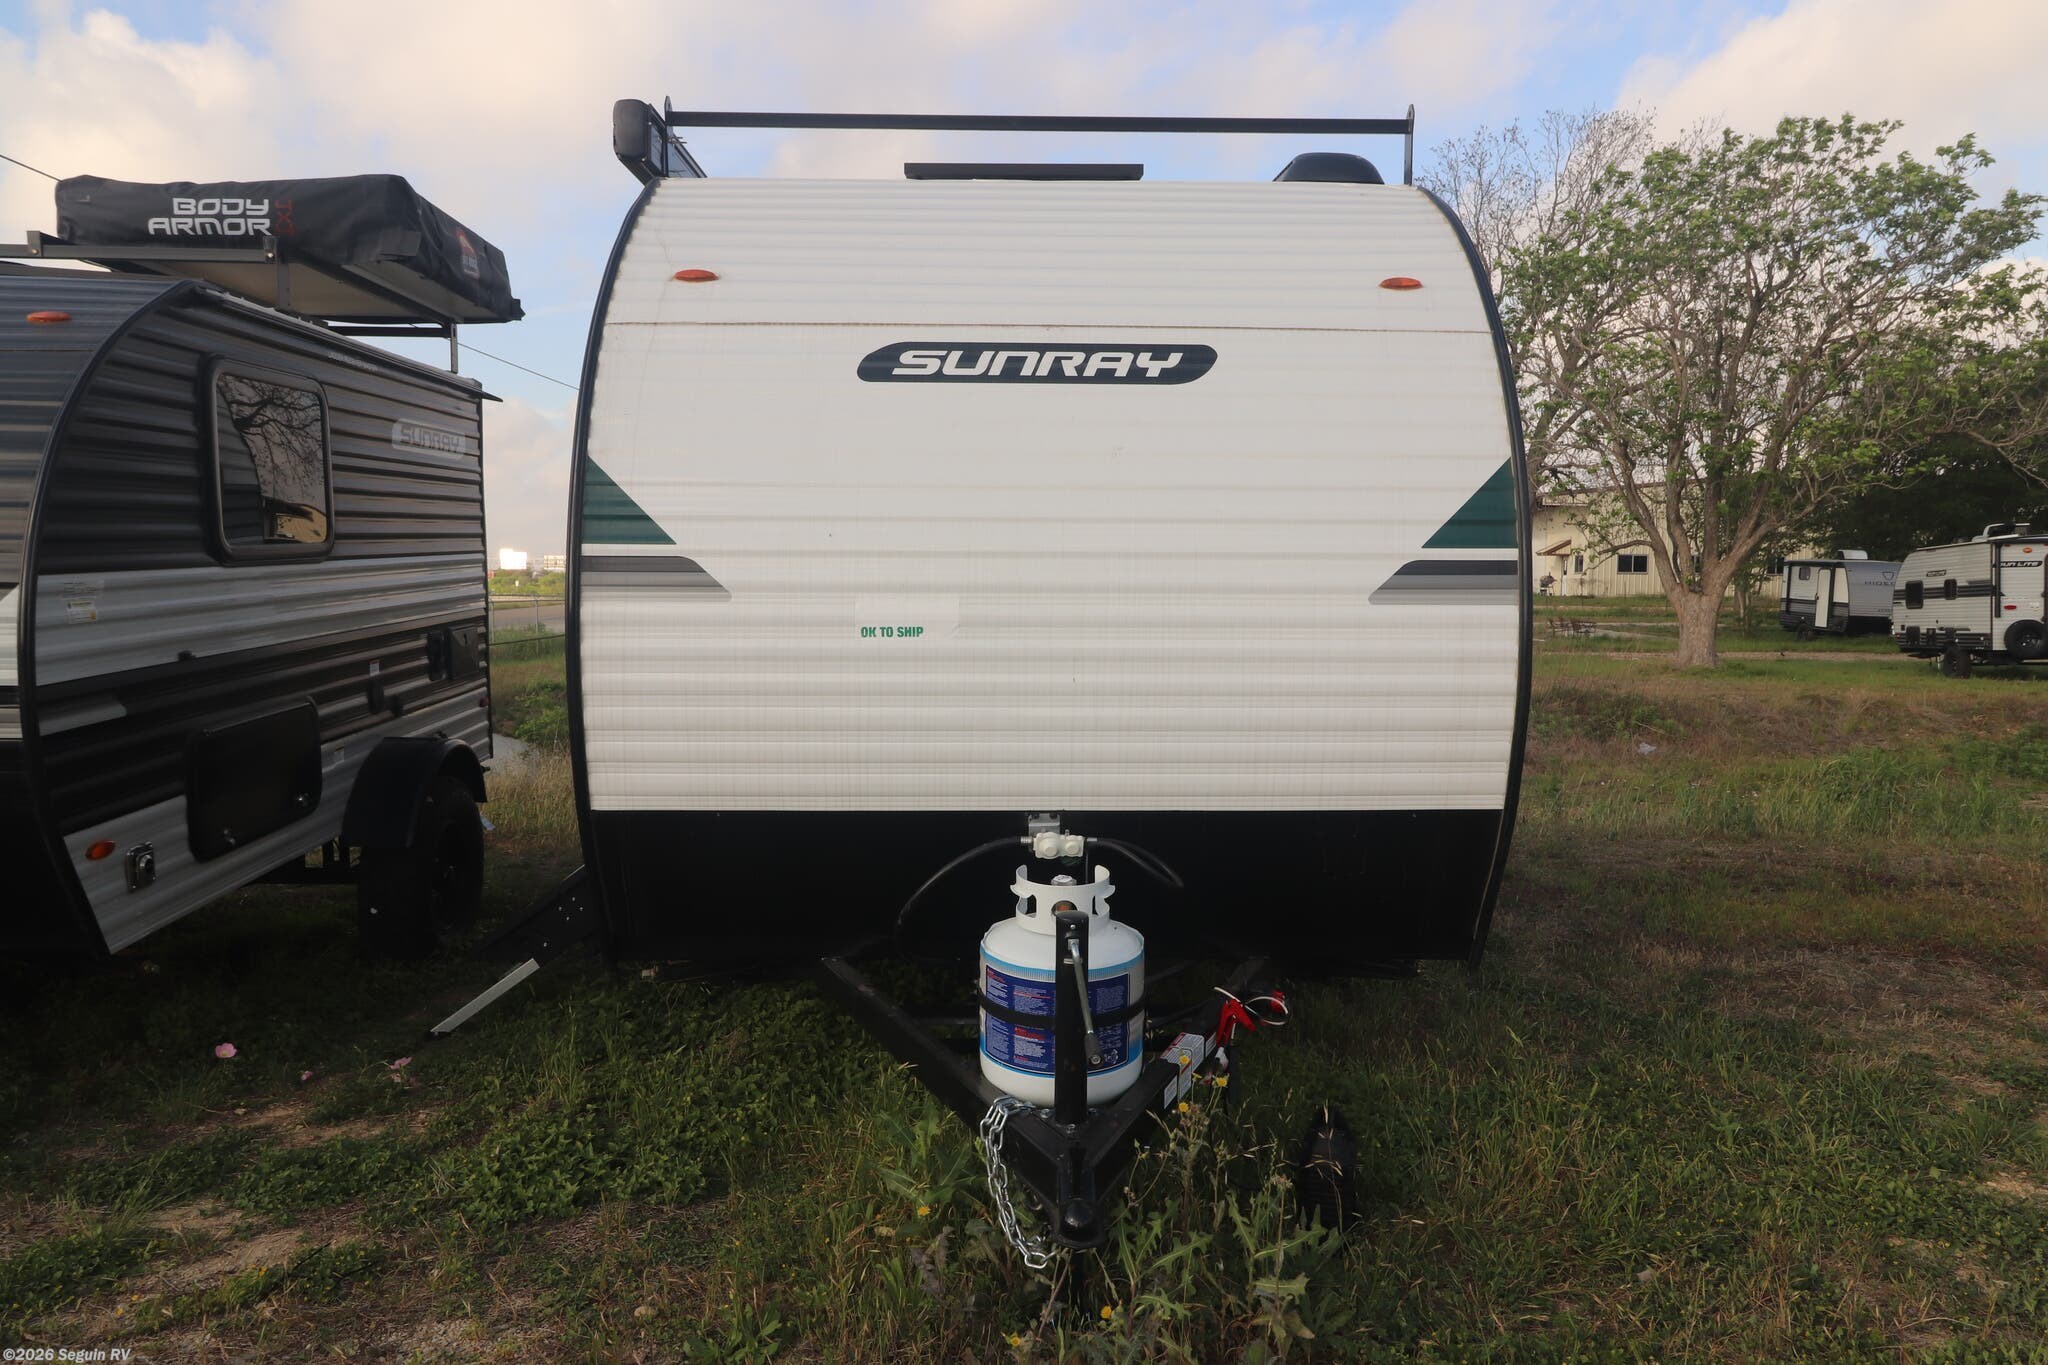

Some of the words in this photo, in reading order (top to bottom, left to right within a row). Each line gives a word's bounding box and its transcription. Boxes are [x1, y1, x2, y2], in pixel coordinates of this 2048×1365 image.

[172, 197, 270, 216] BODY
[147, 217, 272, 236] ARMOR
[892, 350, 1184, 378] SUNRAY
[400, 424, 461, 454] SUNRAY
[861, 626, 877, 638] OK
[879, 626, 894, 638] TO
[897, 626, 924, 638] SHIP
